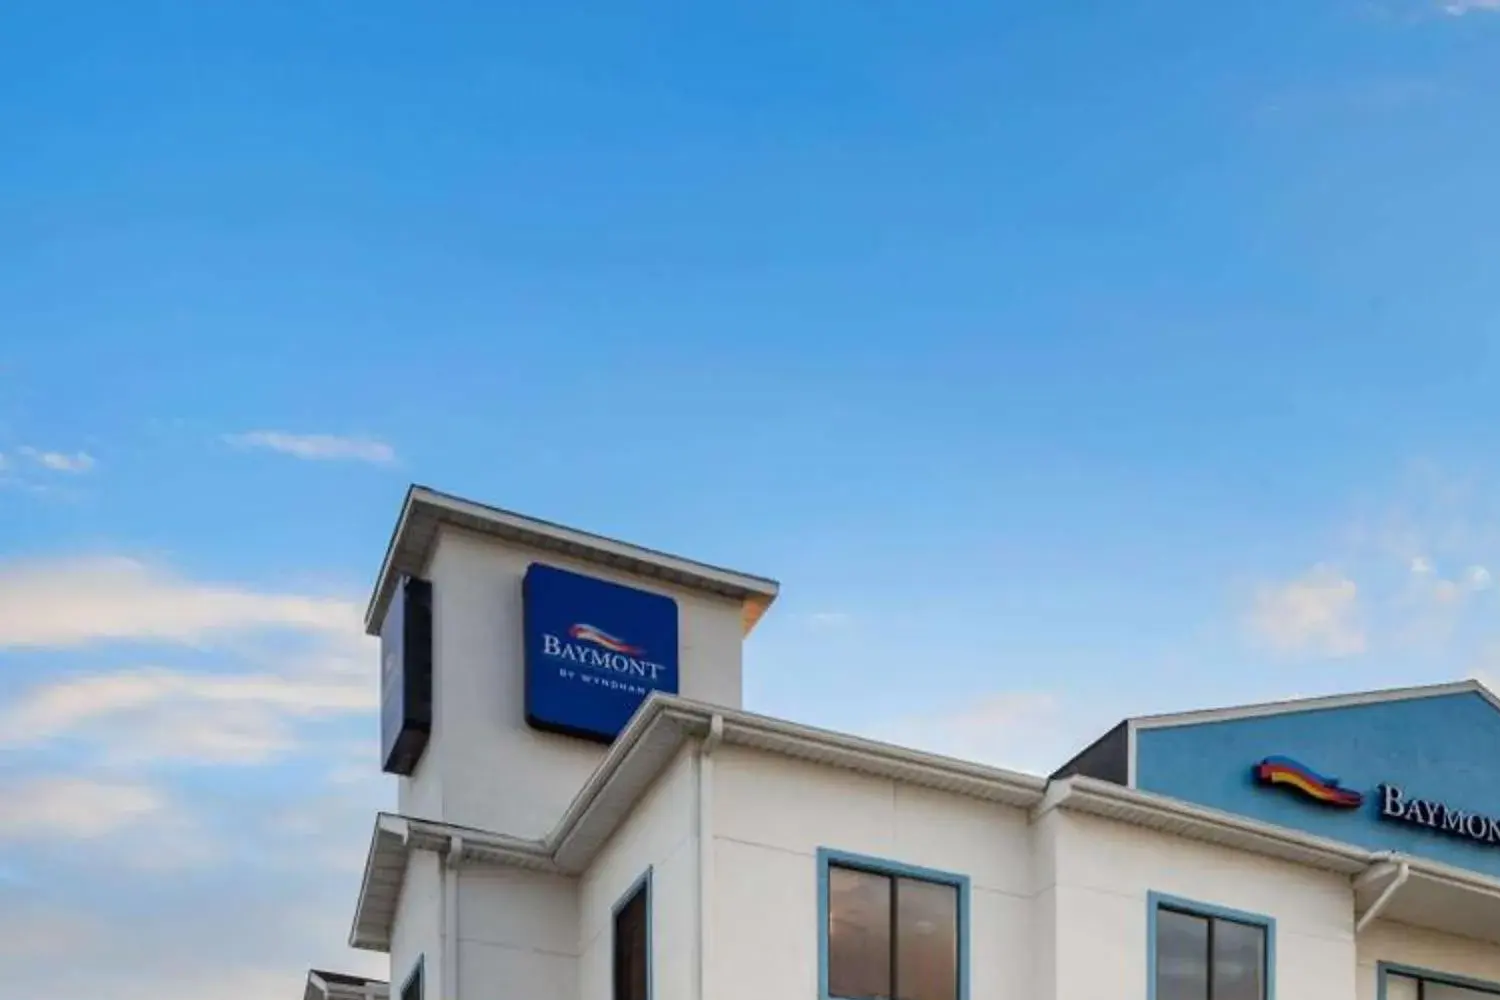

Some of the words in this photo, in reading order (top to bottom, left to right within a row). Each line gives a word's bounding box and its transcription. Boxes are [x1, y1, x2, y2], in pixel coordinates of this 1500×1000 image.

[542, 632, 666, 681] BAYMONT
[559, 667, 576, 682] BY
[580, 675, 646, 695] WYNDHAM
